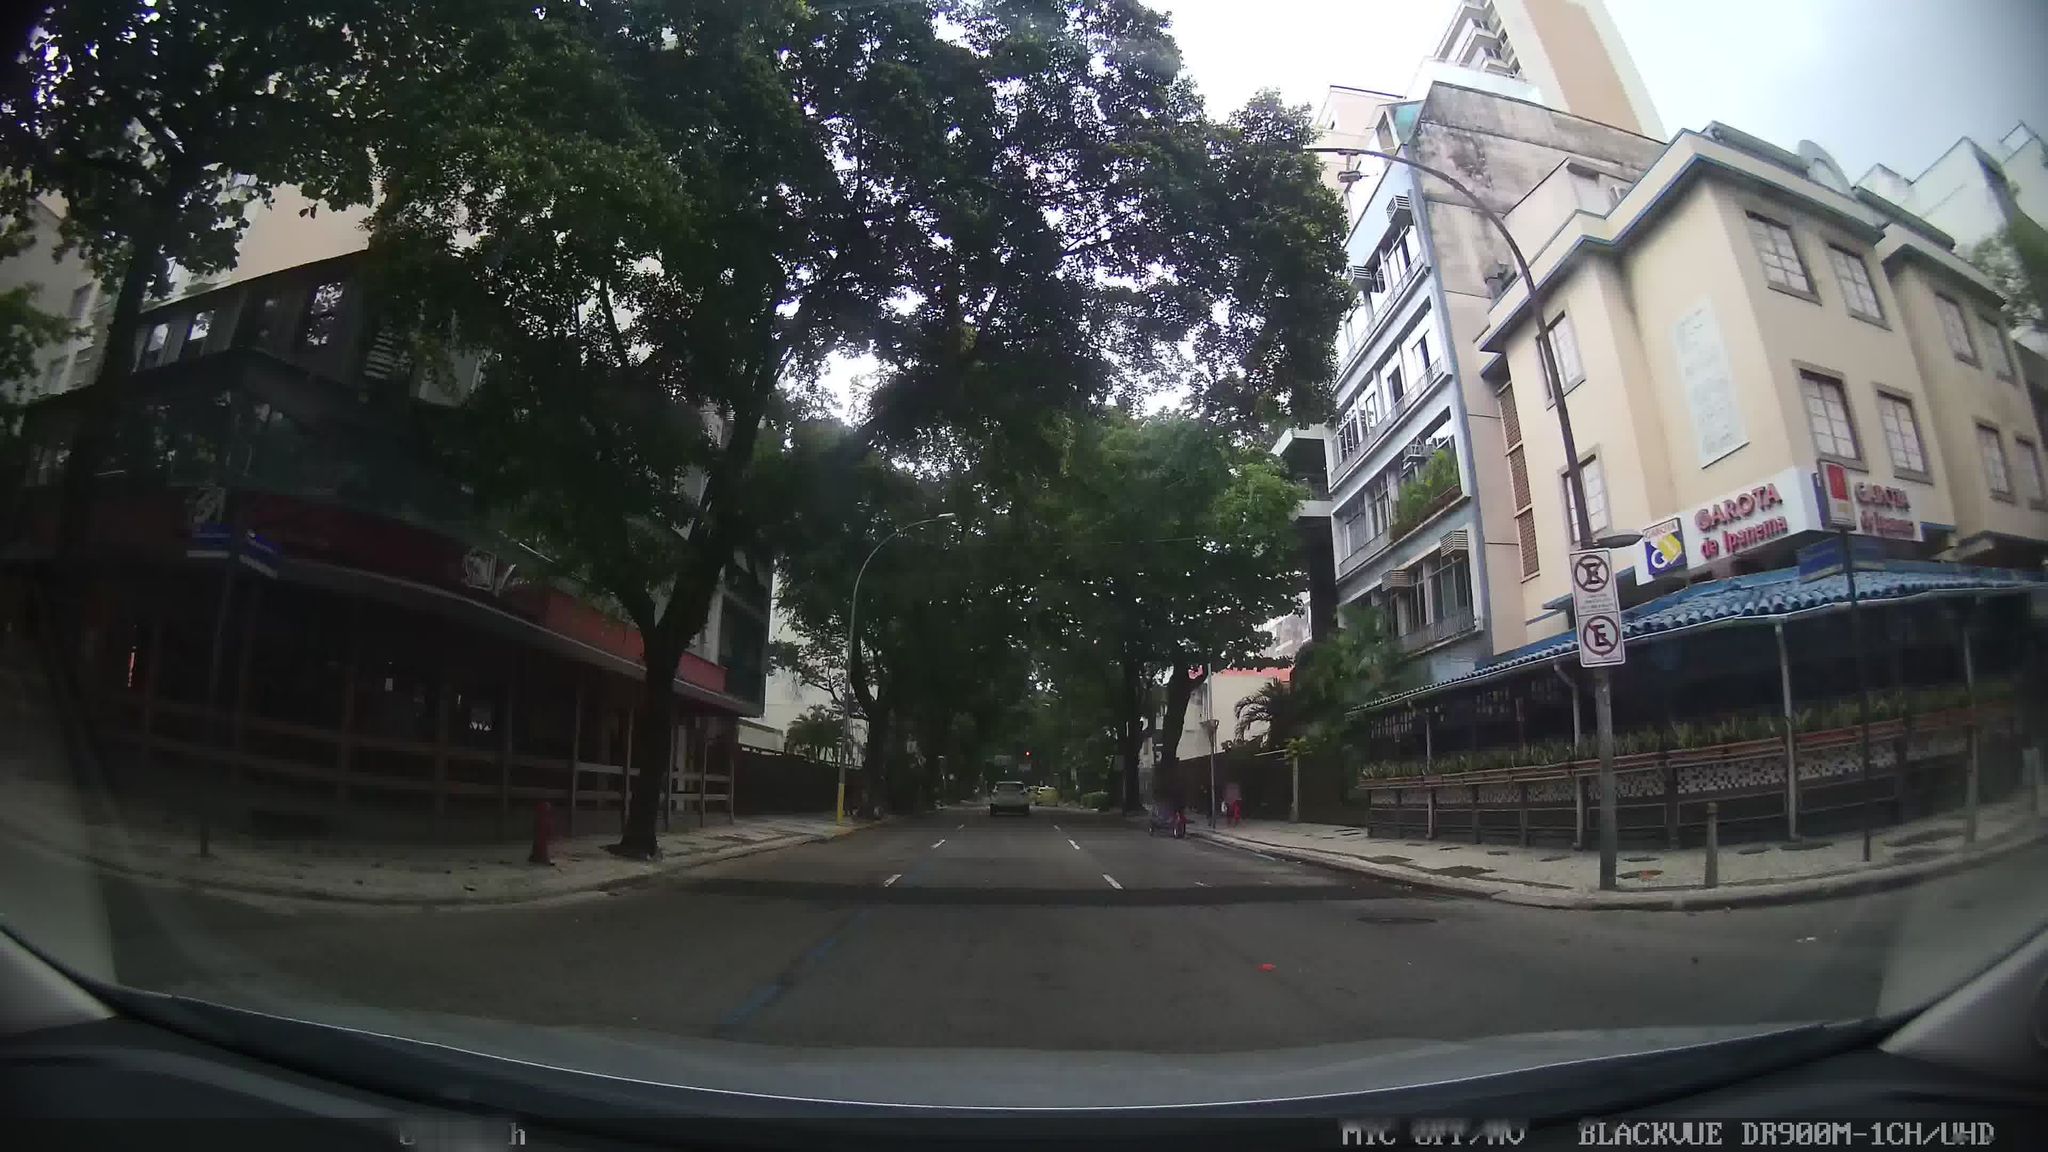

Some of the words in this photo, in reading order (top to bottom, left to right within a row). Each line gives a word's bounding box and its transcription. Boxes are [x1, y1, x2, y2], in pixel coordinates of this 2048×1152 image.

[1694, 483, 1783, 533] GAROTA
[1701, 537, 1719, 559] de
[1722, 516, 1788, 553] Ipanema
[1593, 623, 1608, 647] E
